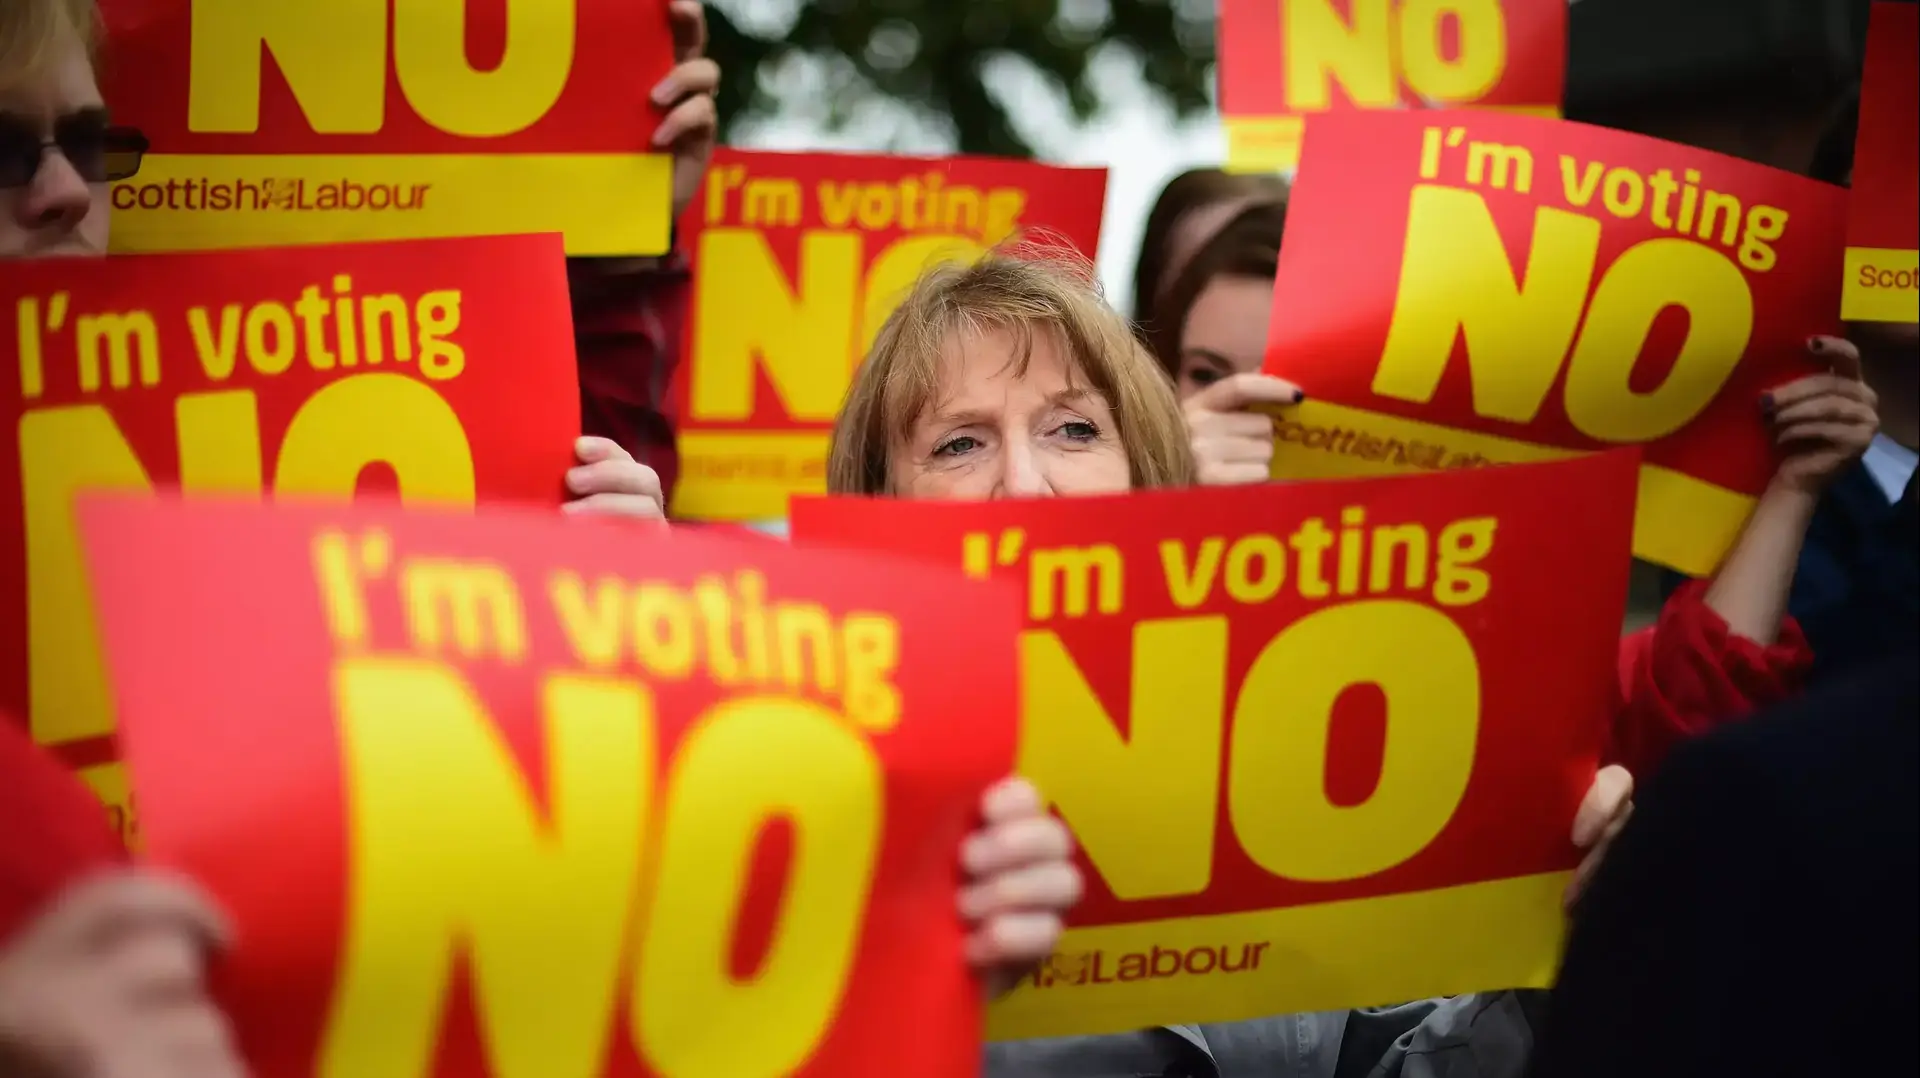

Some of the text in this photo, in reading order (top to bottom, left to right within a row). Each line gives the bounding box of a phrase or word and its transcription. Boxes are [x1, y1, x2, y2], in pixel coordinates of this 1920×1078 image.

[1282, 0, 1506, 110] NO
[111, 177, 431, 210] cottish Labour
[705, 165, 1025, 254] I'm voting
[1419, 126, 1790, 272] I'm voting
[17, 273, 466, 398] I'm voting
[1371, 184, 1754, 442] NO
[1159, 506, 1499, 606] voting
[315, 530, 902, 736] I'm voting
[1014, 599, 1482, 901] NO
[314, 656, 884, 1078] NO
[1092, 941, 1270, 984] Labour
